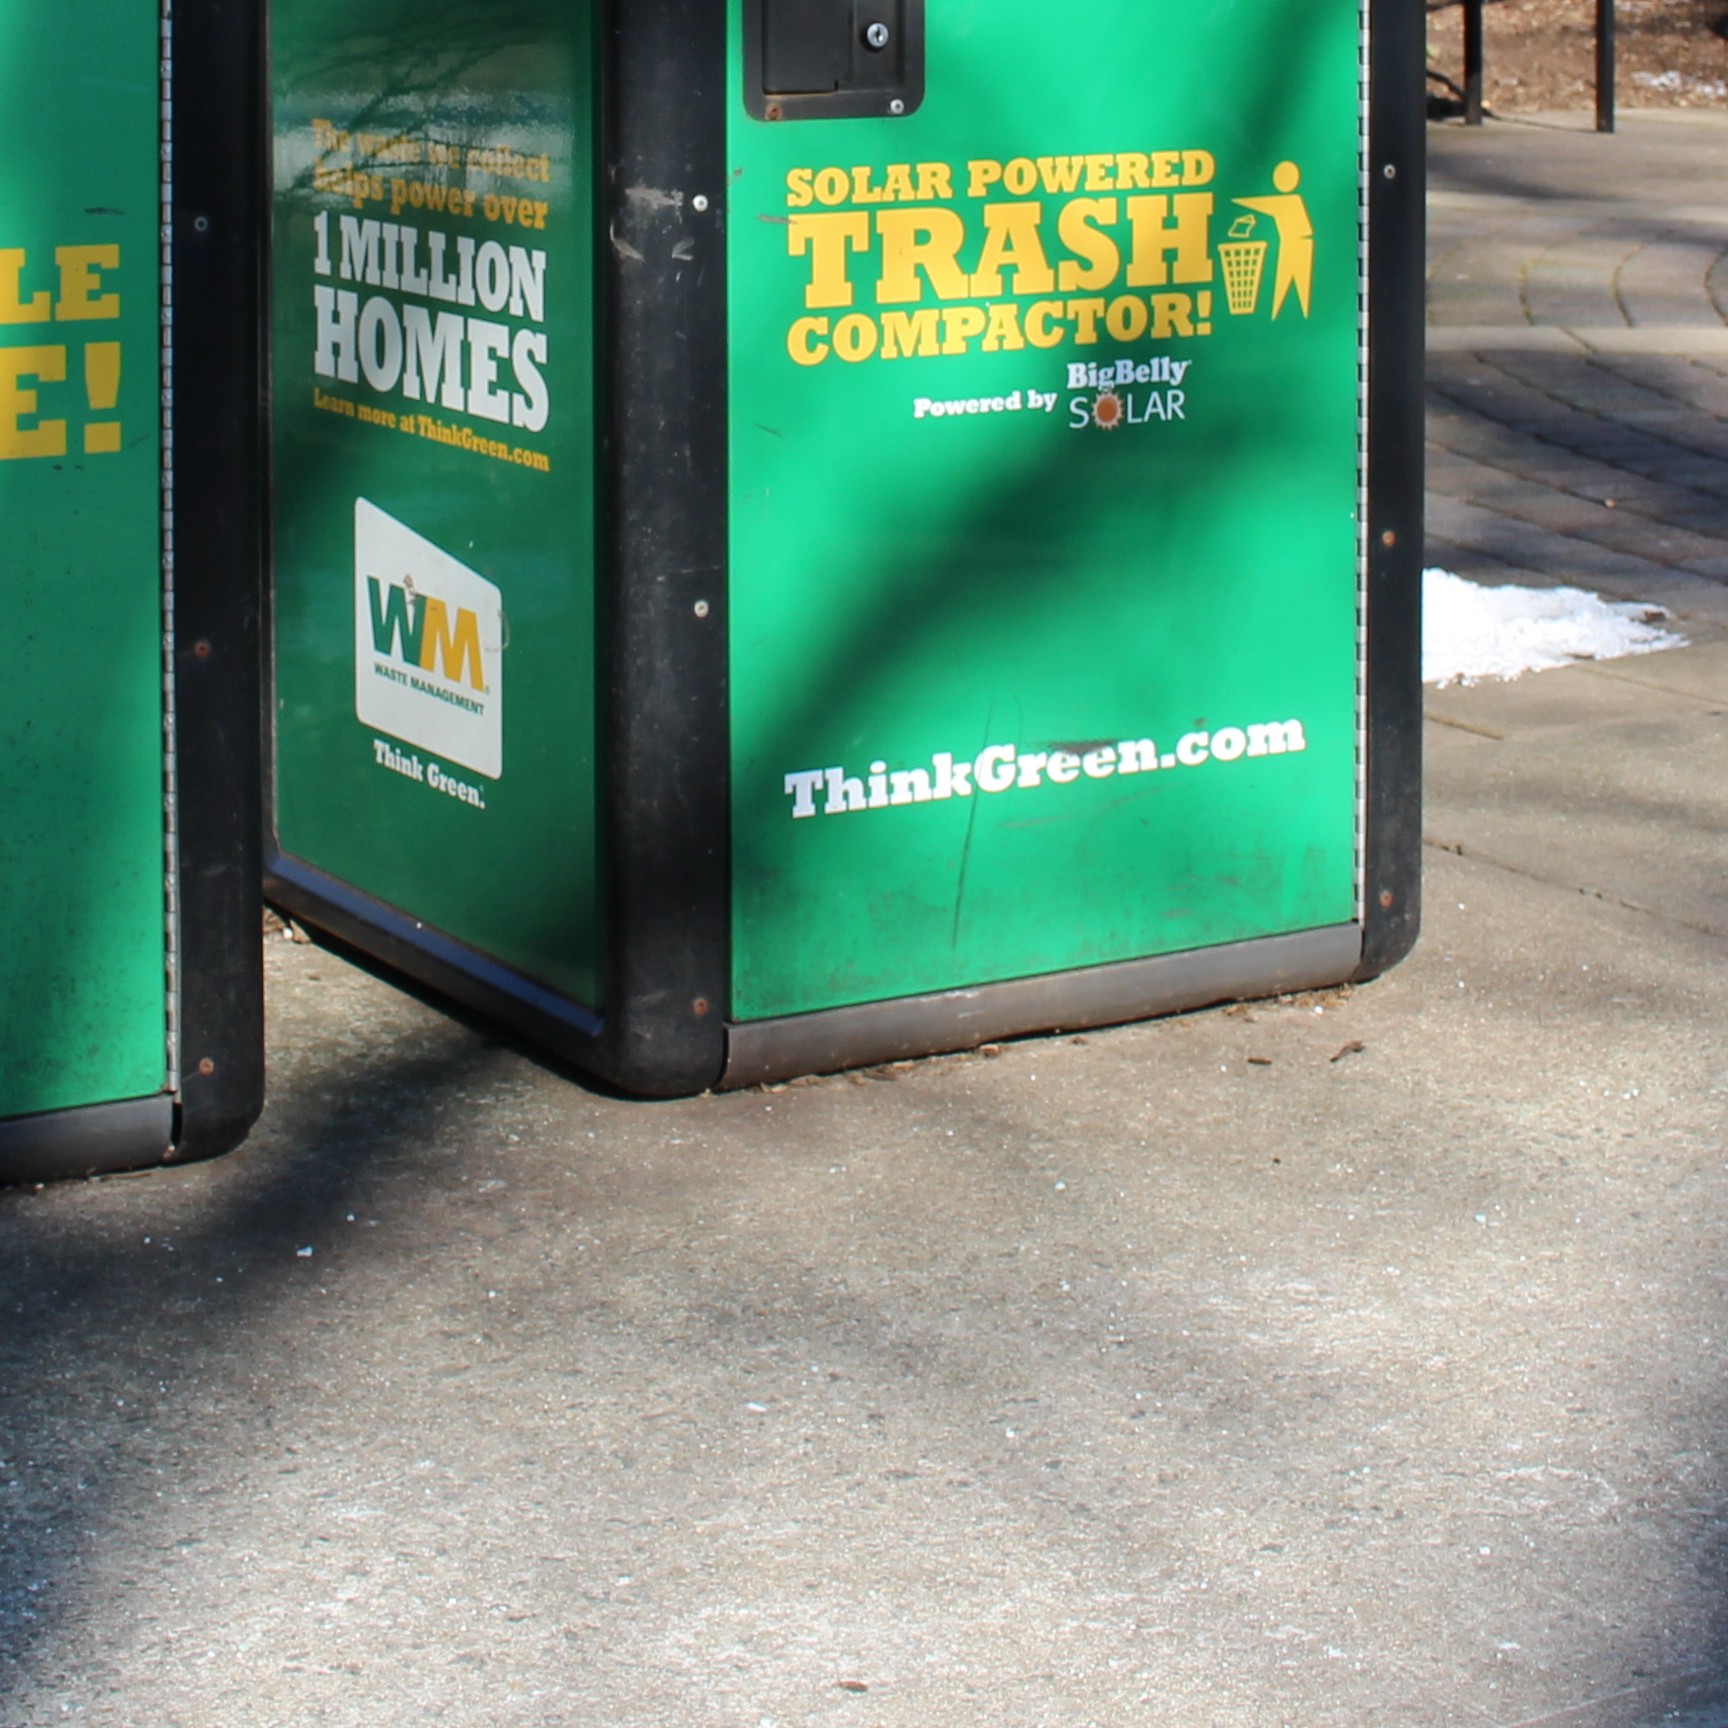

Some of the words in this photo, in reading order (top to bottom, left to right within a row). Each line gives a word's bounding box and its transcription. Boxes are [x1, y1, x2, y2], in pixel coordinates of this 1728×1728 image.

[312, 118, 350, 153] The
[356, 132, 421, 163] waste
[428, 141, 460, 169] we
[466, 143, 550, 184] collect
[786, 162, 953, 207] SOLAR
[967, 149, 1215, 197] POWERED
[312, 157, 384, 209] helps
[391, 177, 476, 217] power
[483, 193, 548, 230] over
[314, 210, 332, 276] 1
[339, 215, 546, 322] MILLION
[787, 192, 1214, 309] TRASH
[313, 284, 550, 433] HOMES
[787, 290, 1213, 366] COMPACTOR!
[913, 391, 1022, 419] Powered
[1027, 388, 1058, 414] by
[1066, 356, 1190, 393] BigBelly
[313, 387, 355, 417] Learn
[358, 404, 396, 429] more
[400, 413, 416, 434] at
[418, 414, 551, 472] ThinkGreen.com
[366, 574, 485, 693] WM
[374, 662, 409, 691] WASTE
[410, 677, 484, 716] MANAGEMENT
[374, 738, 423, 781] Think
[427, 763, 485, 809] Green.
[784, 717, 1306, 819] ThinkGreen.com
